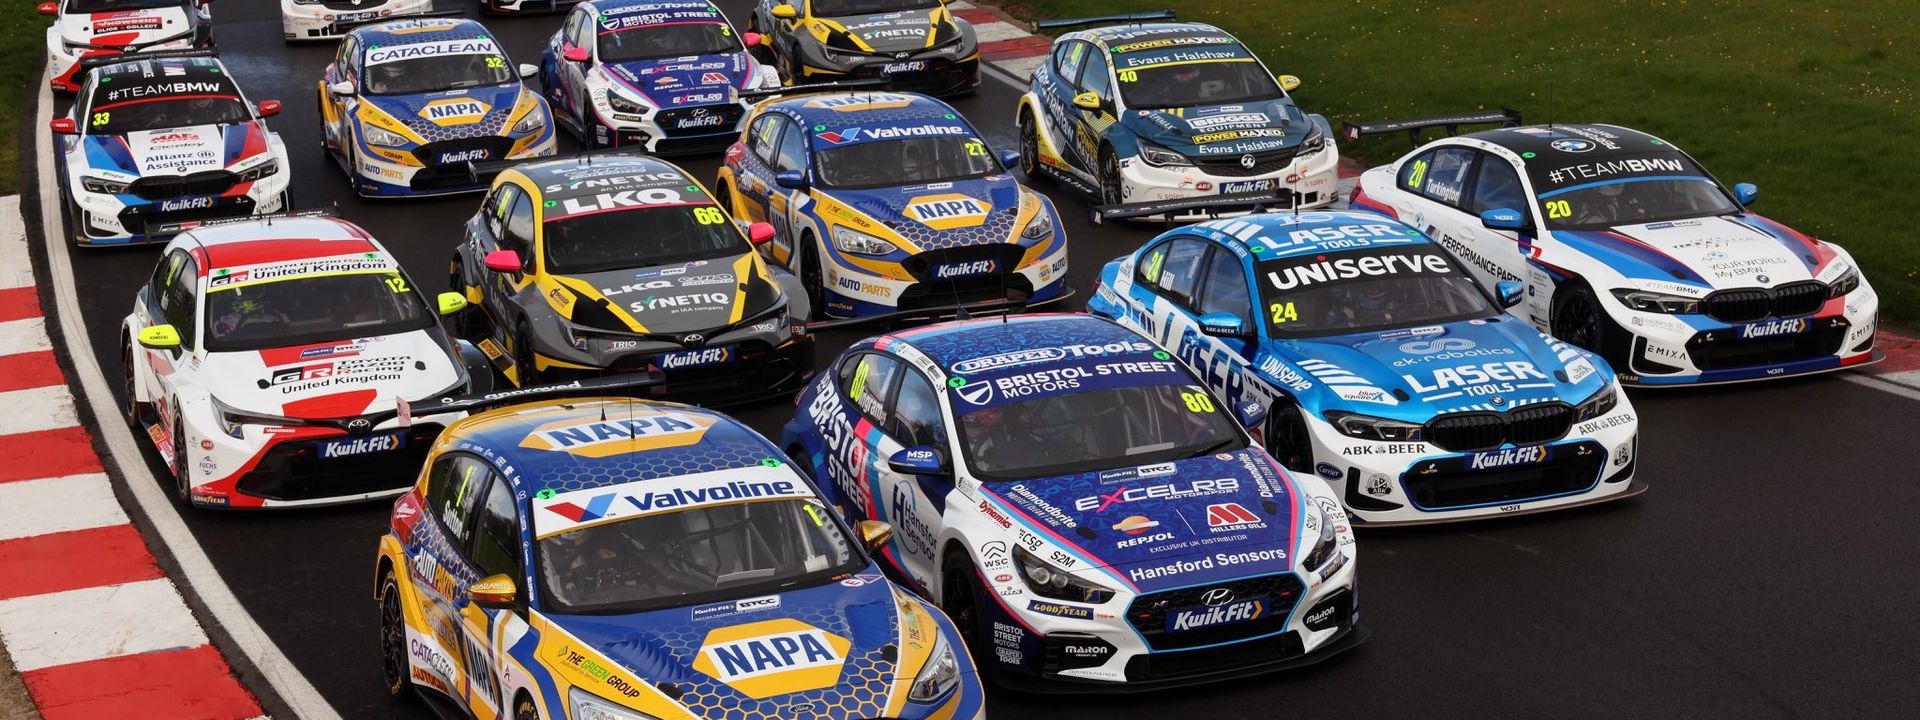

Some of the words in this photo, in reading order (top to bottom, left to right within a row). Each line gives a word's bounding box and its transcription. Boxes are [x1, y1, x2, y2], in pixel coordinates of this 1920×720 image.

[622, 12, 672, 23] BRISTOL
[624, 19, 665, 27] MOTORS
[721, 25, 731, 36] 3
[846, 22, 890, 30] LKQ
[864, 28, 926, 41] SYNETIQ
[370, 42, 492, 63] CATACLEAN
[1119, 39, 1173, 52] POWER
[485, 57, 505, 68] 32
[1127, 53, 1171, 66] Evans
[1174, 50, 1236, 61] Halshaw
[641, 62, 725, 76] EXCELR8
[1120, 70, 1138, 83] 40
[108, 82, 220, 101] #TEAMBMW
[673, 93, 723, 104] EXCELR8
[823, 94, 905, 107] NAPA
[429, 102, 482, 118] NAPA
[92, 112, 111, 126] 33
[1193, 114, 1264, 126] BRIGGS
[863, 126, 963, 141] Valvoline
[1194, 132, 1238, 143] POWER
[1239, 129, 1281, 138] MAXED
[1199, 123, 1268, 133] EQUIPMENT
[384, 151, 403, 159] OSRAM
[965, 143, 985, 156] 27
[1200, 145, 1233, 154] Evans
[1236, 140, 1283, 153] Halshaw
[145, 151, 194, 163] Allianz
[146, 158, 217, 171] Assistance
[365, 163, 381, 175] AUTO
[381, 168, 404, 180] PARTS
[1408, 159, 1427, 188] 20
[1549, 159, 1683, 183] #TEAMBMW
[545, 173, 684, 193] SYNETIQ
[1426, 178, 1460, 202] Turkington
[563, 188, 687, 214] LKQ
[693, 207, 725, 225] 66
[914, 200, 981, 219] NAPA
[1546, 200, 1572, 219] 20
[1260, 226, 1404, 251] LASER
[1319, 238, 1371, 251] TOOLS
[1441, 233, 1496, 276] PERFORMANCE
[254, 264, 307, 280] United
[313, 260, 387, 274] Kingdom
[1146, 251, 1164, 283] 24
[1709, 258, 1743, 271] YOUR
[1746, 256, 1788, 267] WORLD
[385, 277, 410, 295] 12
[602, 280, 674, 297] LKQ
[839, 277, 861, 292] AUTO
[861, 282, 892, 298] PARTS
[1159, 270, 1175, 291] Hill
[630, 293, 729, 314] SYNETIQ
[1271, 303, 1298, 324] 24
[752, 323, 774, 332] TRIO
[611, 340, 637, 348] TRIO
[339, 355, 411, 365] TOYOTA
[963, 351, 1052, 371] DRAPER
[1063, 341, 1152, 356] Tools
[272, 362, 333, 385] GR
[336, 365, 404, 376] Racing
[996, 369, 1093, 391] BRISTOL
[1095, 361, 1177, 375] STREET
[1402, 361, 1549, 394] LASER
[282, 378, 330, 394] United
[335, 372, 401, 387] Kingdom
[1001, 378, 1081, 399] MOTORS
[1461, 382, 1515, 397] TOOLS
[1181, 392, 1215, 414] 80
[1243, 402, 1260, 415] MSP
[549, 415, 695, 447] NAPA
[1578, 422, 1602, 436] ABK
[1608, 413, 1635, 426] BEER
[907, 450, 933, 459] MSP
[1343, 445, 1373, 456] ABK
[1389, 444, 1426, 454] BEER
[1318, 465, 1340, 478] Carrier
[624, 479, 795, 511] Valvoline
[1075, 477, 1241, 512] EXCELR8
[1165, 489, 1240, 501] MOTORSPORT
[979, 500, 1012, 529] Dynamics
[1011, 484, 1077, 529] Diamondbrite
[802, 504, 823, 527] 1
[1210, 525, 1247, 533] MILLERS
[1116, 532, 1175, 549] REPSOL
[1149, 544, 1189, 554] EXCLUSIVE
[1201, 534, 1248, 545] DISTRIBUTOR
[984, 558, 1009, 568] WSC
[1050, 551, 1076, 568] S2M
[1130, 554, 1214, 583] Hansford
[1215, 547, 1287, 567] Sensors
[416, 547, 437, 583] AUTO
[435, 562, 456, 601] PARTS
[739, 599, 776, 607] BTCC
[1033, 603, 1088, 617] GOODYEAR
[993, 630, 1021, 642] STREET
[994, 622, 1025, 636] BRISTOL
[993, 638, 1020, 649] MOTORS
[713, 632, 834, 676] NAPA
[567, 650, 583, 665] THE
[580, 657, 609, 680] GREEN
[606, 674, 640, 698] GROUP
